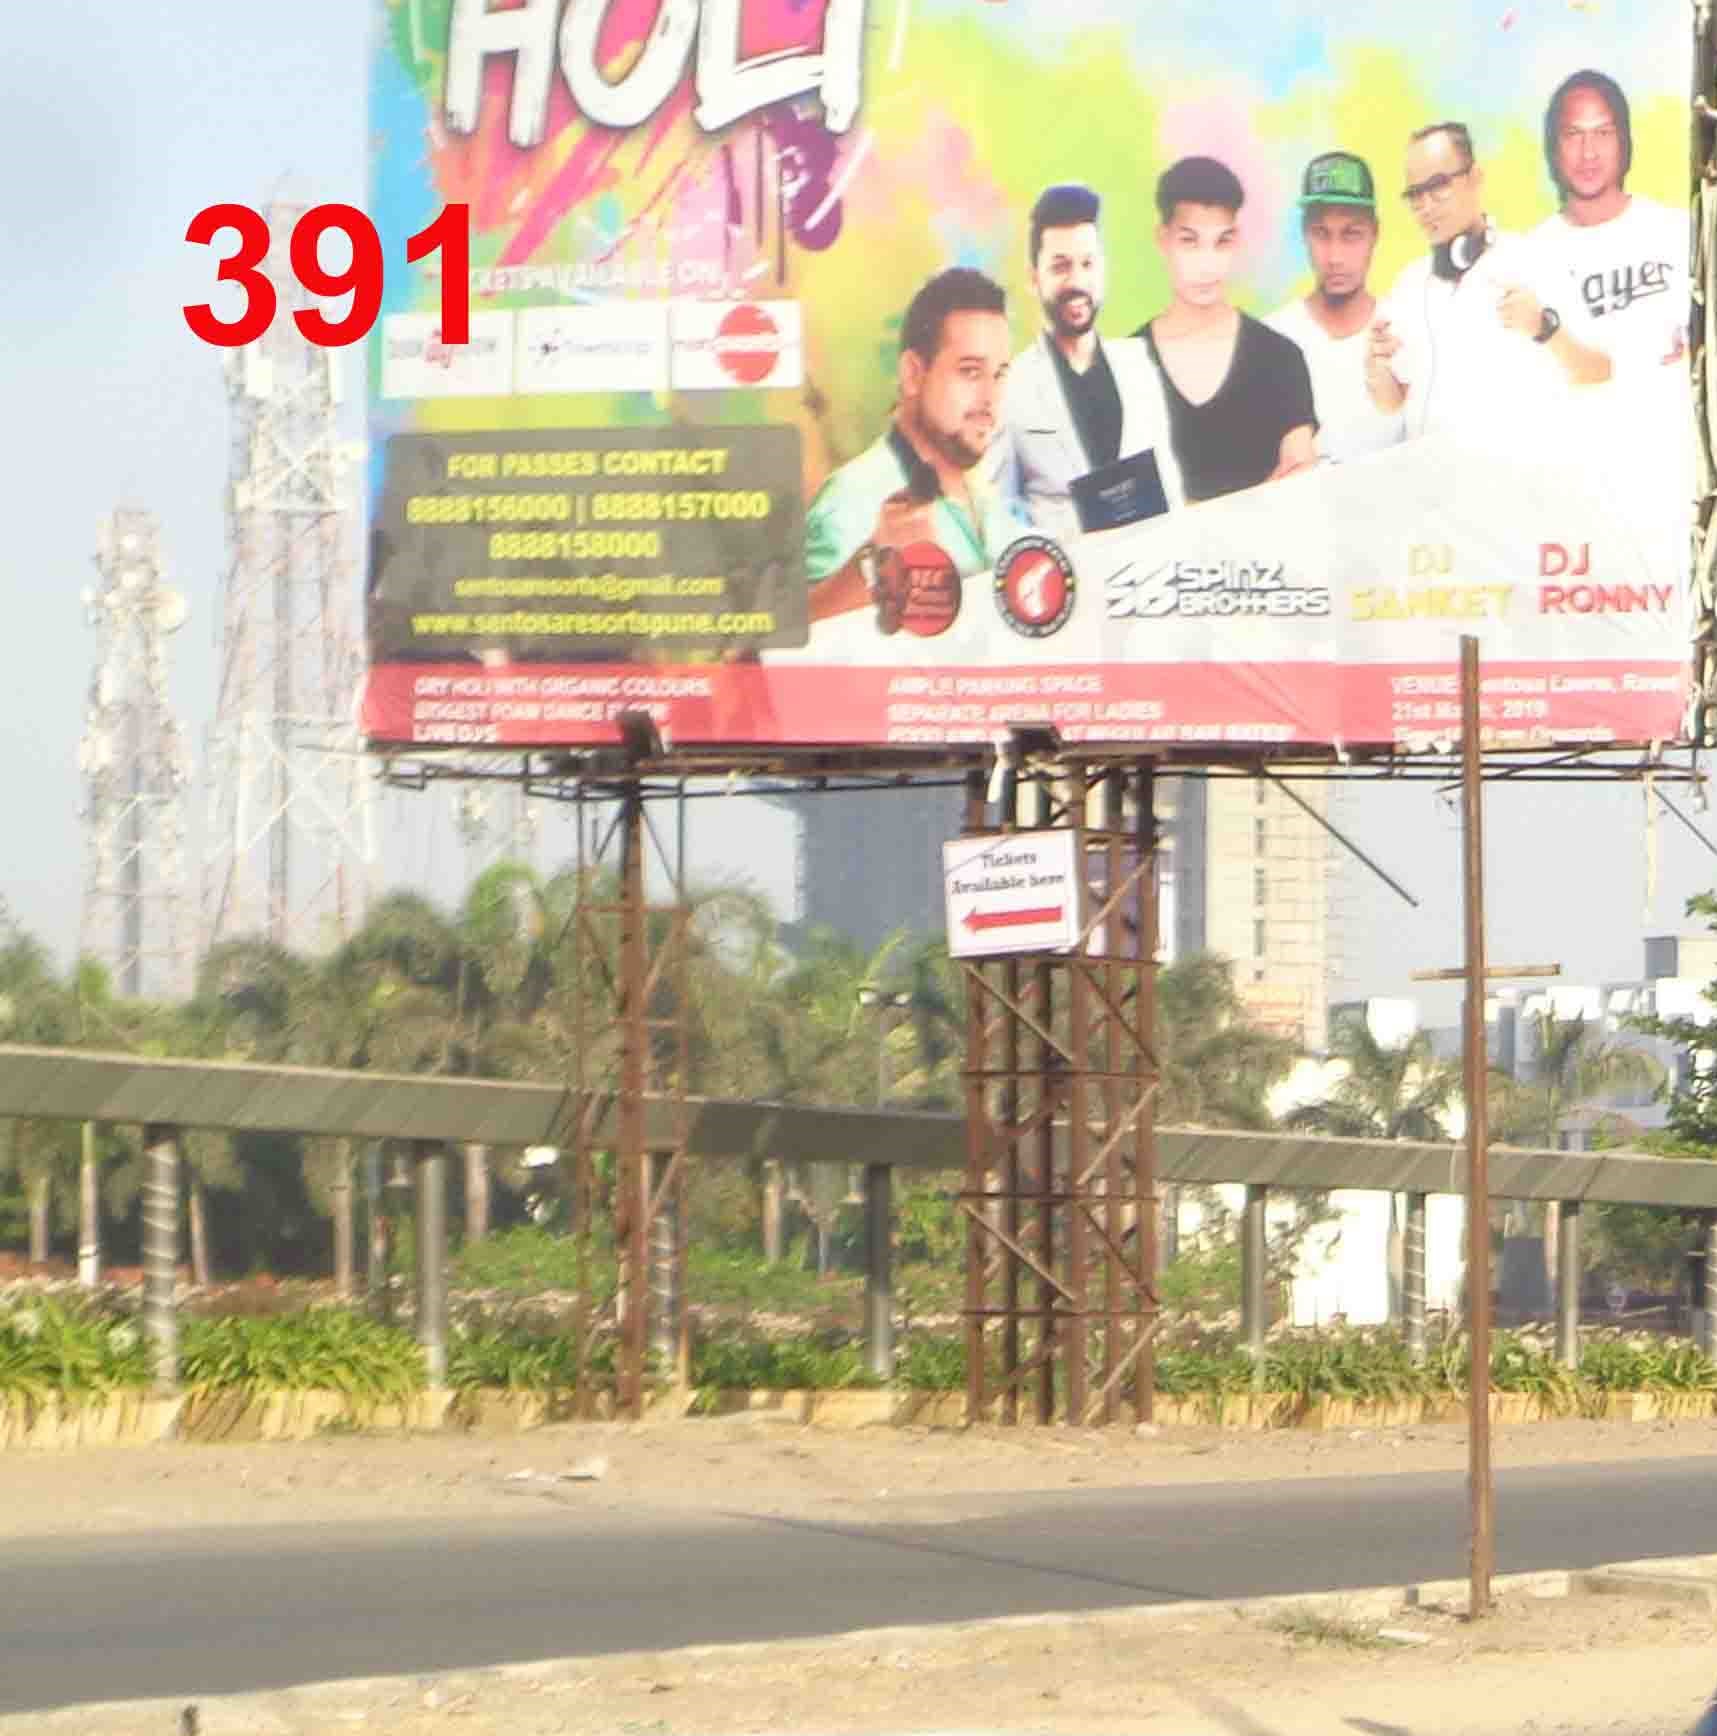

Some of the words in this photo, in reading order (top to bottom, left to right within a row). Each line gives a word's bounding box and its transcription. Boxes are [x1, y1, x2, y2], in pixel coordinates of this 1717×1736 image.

[447, 453, 496, 479] FOR
[501, 451, 596, 478] PASSES
[602, 449, 728, 476] CONTACT
[1409, 543, 1455, 576] DJ
[1539, 543, 1591, 576] DJ
[1178, 588, 1330, 616] BROTHERS
[1539, 585, 1675, 615] RONNY
[981, 852, 1037, 870] Tickets
[951, 873, 1025, 896] Available
[1029, 872, 1066, 888] here
